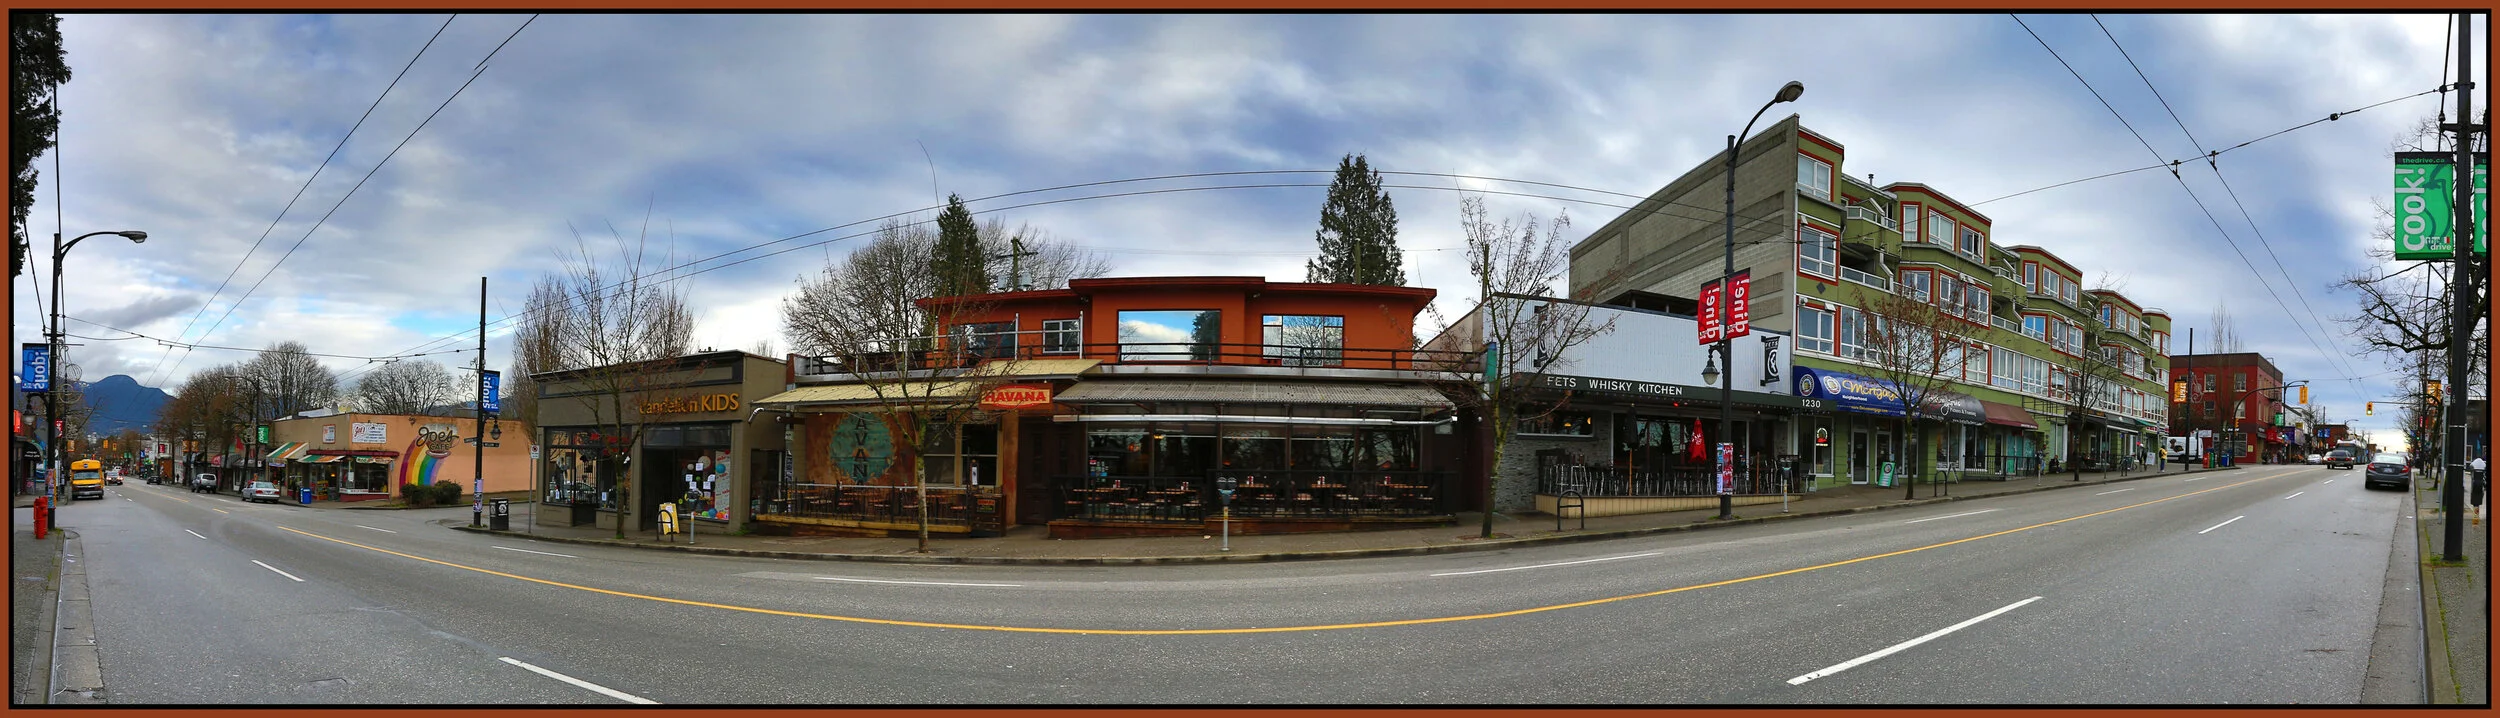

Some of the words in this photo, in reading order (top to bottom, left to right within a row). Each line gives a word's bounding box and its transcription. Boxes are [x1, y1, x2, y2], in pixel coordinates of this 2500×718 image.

[2395, 168, 2426, 251] cook!
[984, 390, 1047, 402] HAVANA
[1547, 376, 1577, 388] FETS
[1588, 379, 1632, 392] WHISKY
[1638, 383, 1683, 396] KITCHEN
[701, 392, 740, 413] KIDS
[1801, 398, 1821, 408] 1230
[417, 426, 460, 447] Joe's
